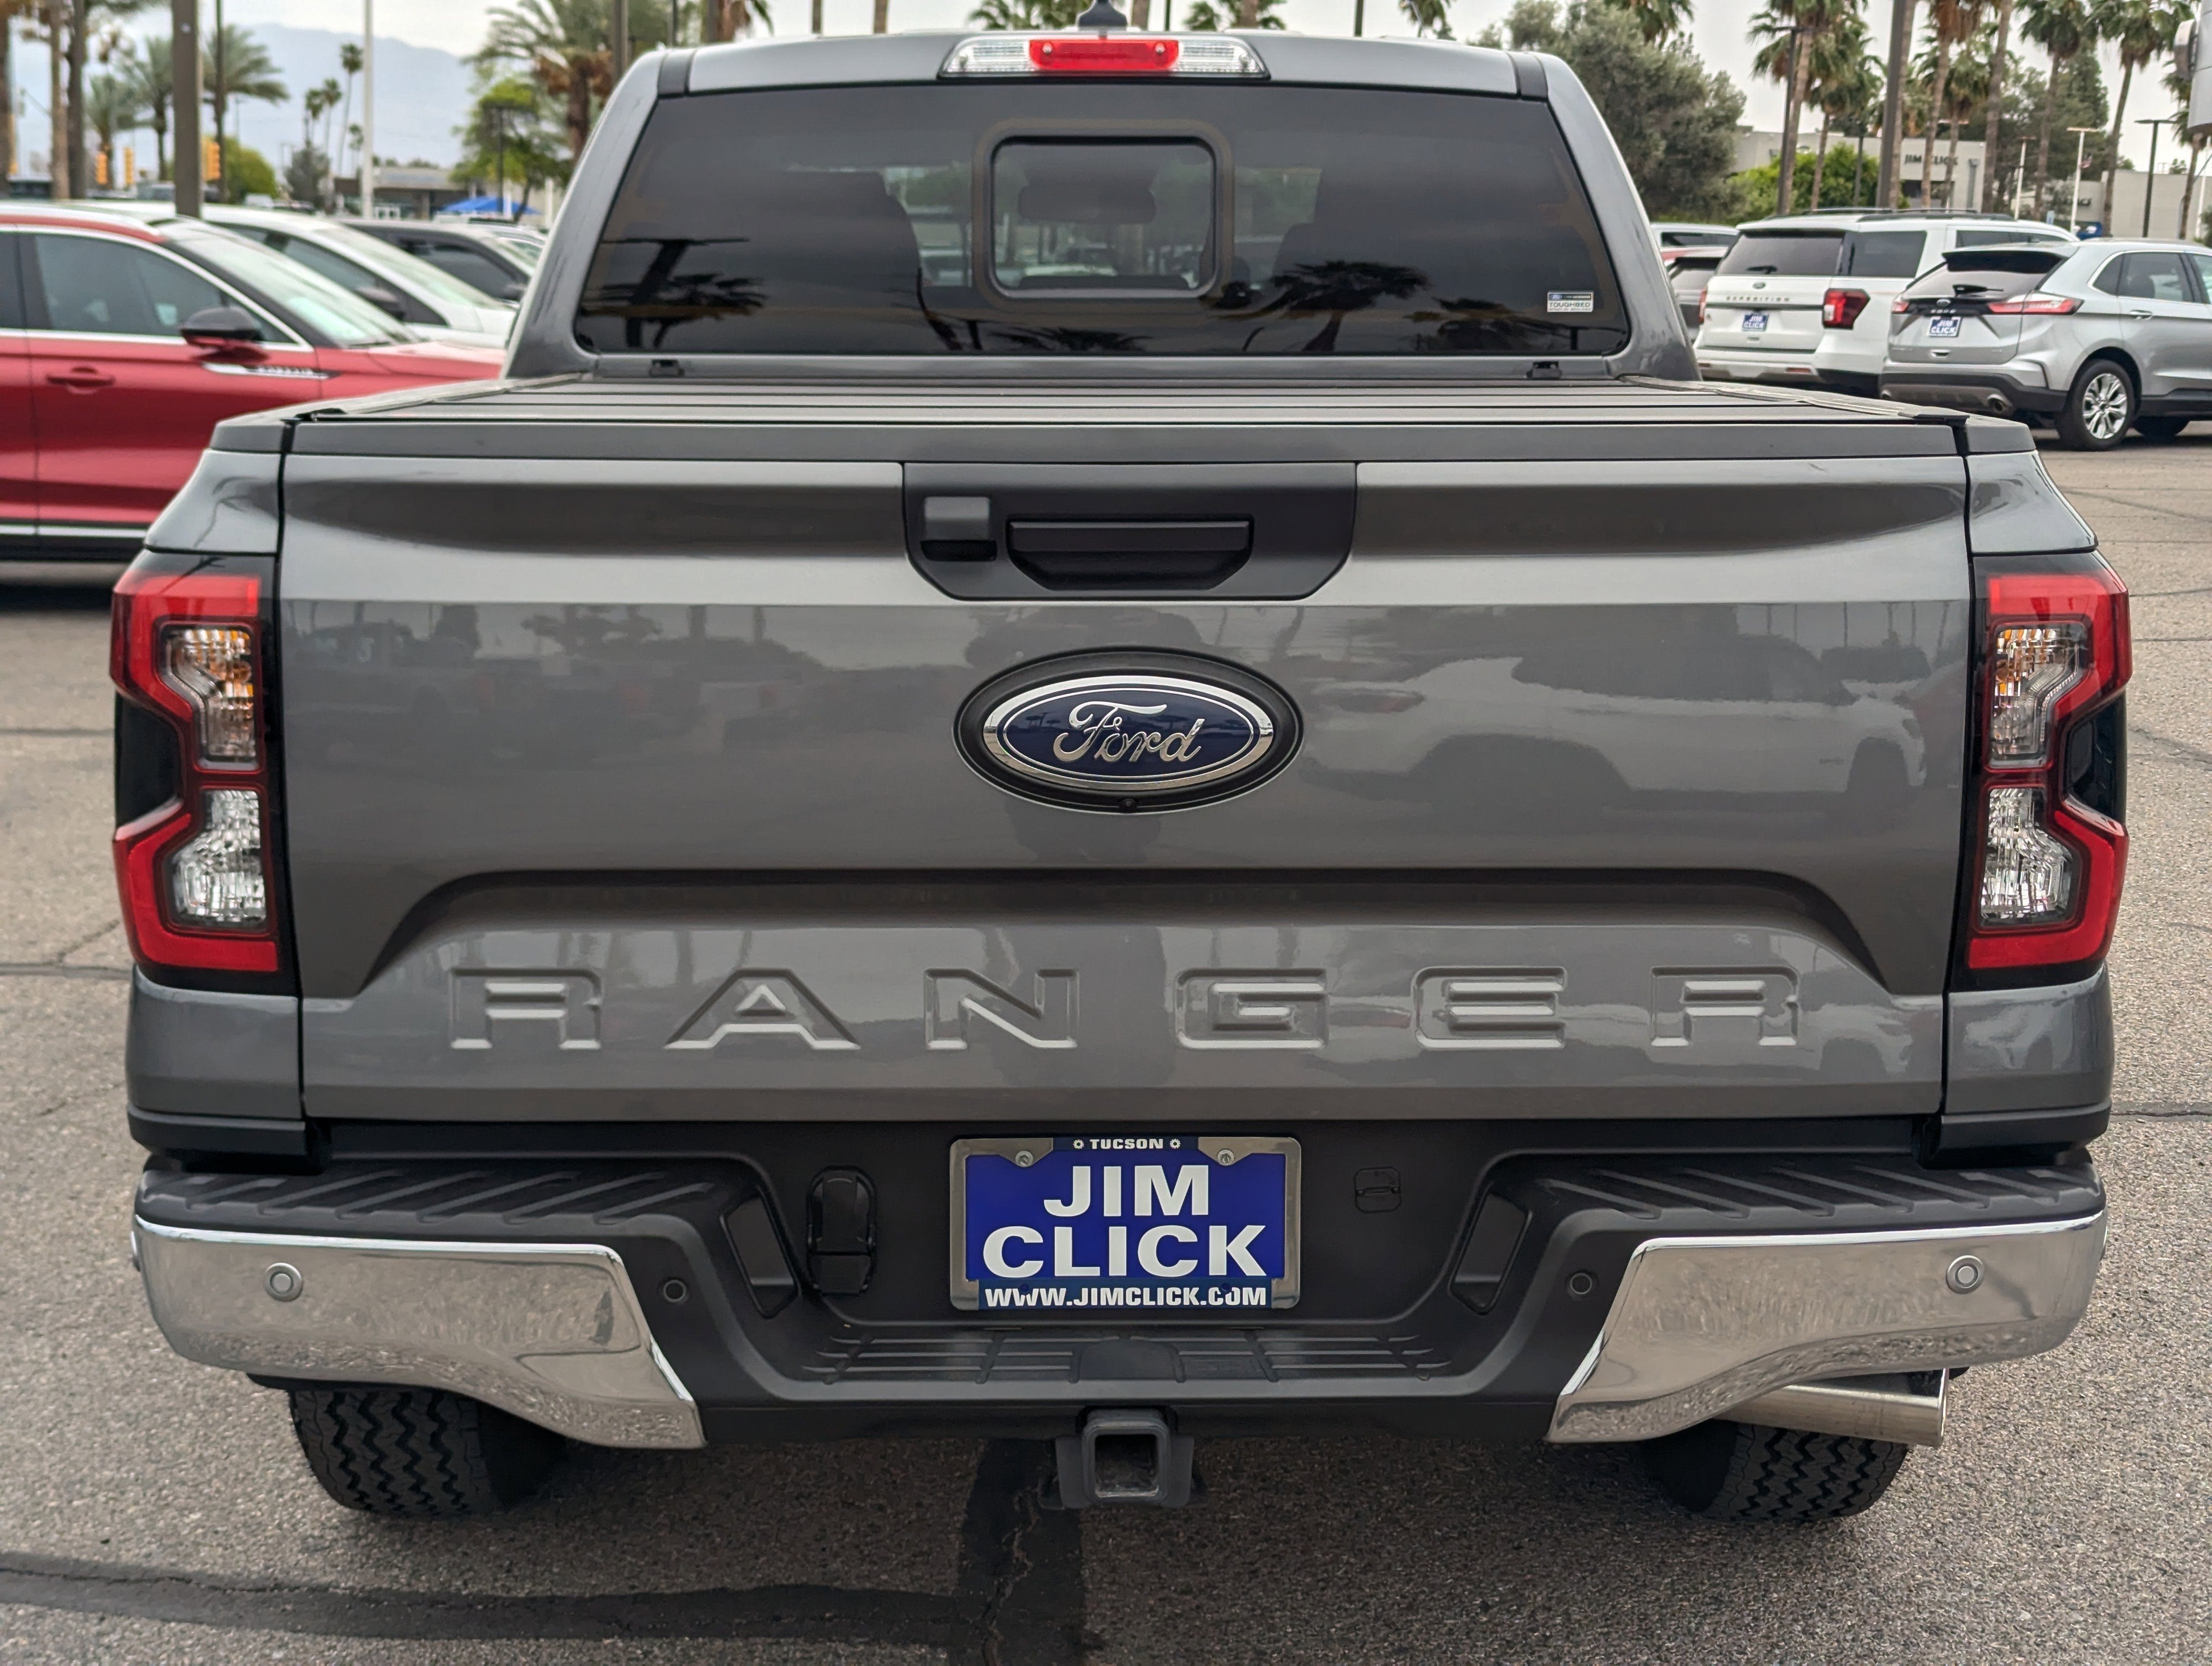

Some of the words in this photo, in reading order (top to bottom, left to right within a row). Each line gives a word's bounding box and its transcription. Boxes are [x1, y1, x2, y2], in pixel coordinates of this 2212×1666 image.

[1053, 701, 1205, 762] Ford
[450, 966, 1800, 1049] RANGER
[1090, 1138, 1164, 1150] TUCSON
[1044, 1164, 1209, 1217] JIM
[983, 1225, 1267, 1278] CLICK
[985, 1287, 1266, 1306] WWW.JIMCLICK.COM
